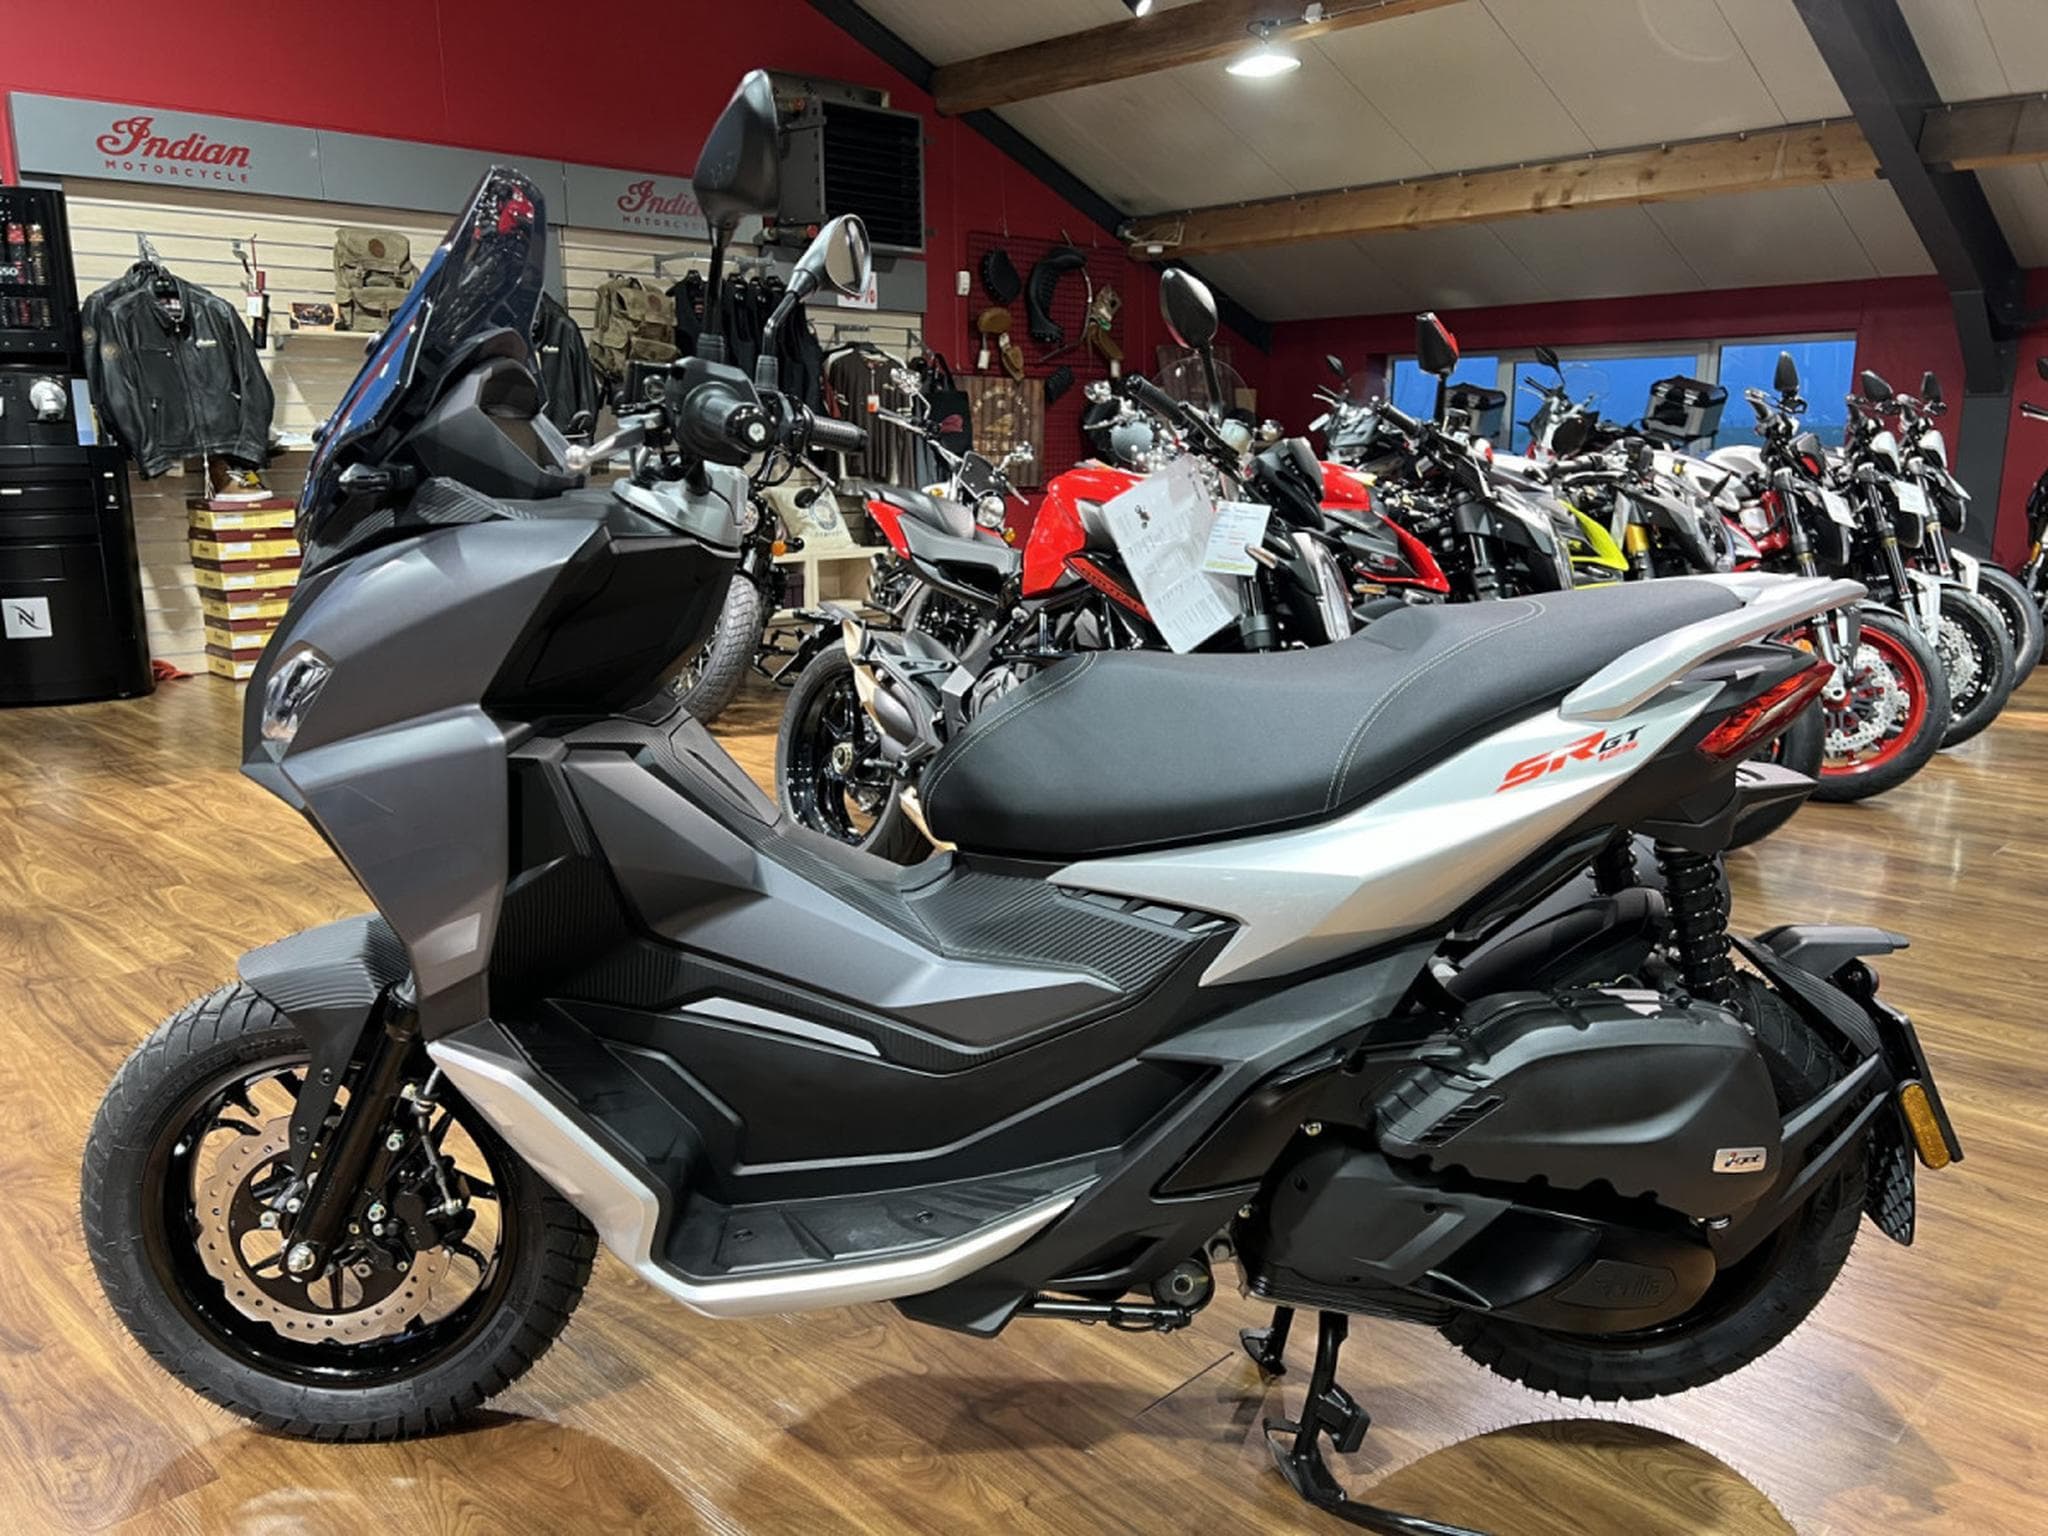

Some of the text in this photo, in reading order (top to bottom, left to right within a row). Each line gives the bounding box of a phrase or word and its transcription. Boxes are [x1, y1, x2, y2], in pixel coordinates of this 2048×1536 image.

[96, 116, 250, 168] Indian
[105, 160, 248, 183] MOTORCYCLE
[1598, 724, 1646, 753] GT
